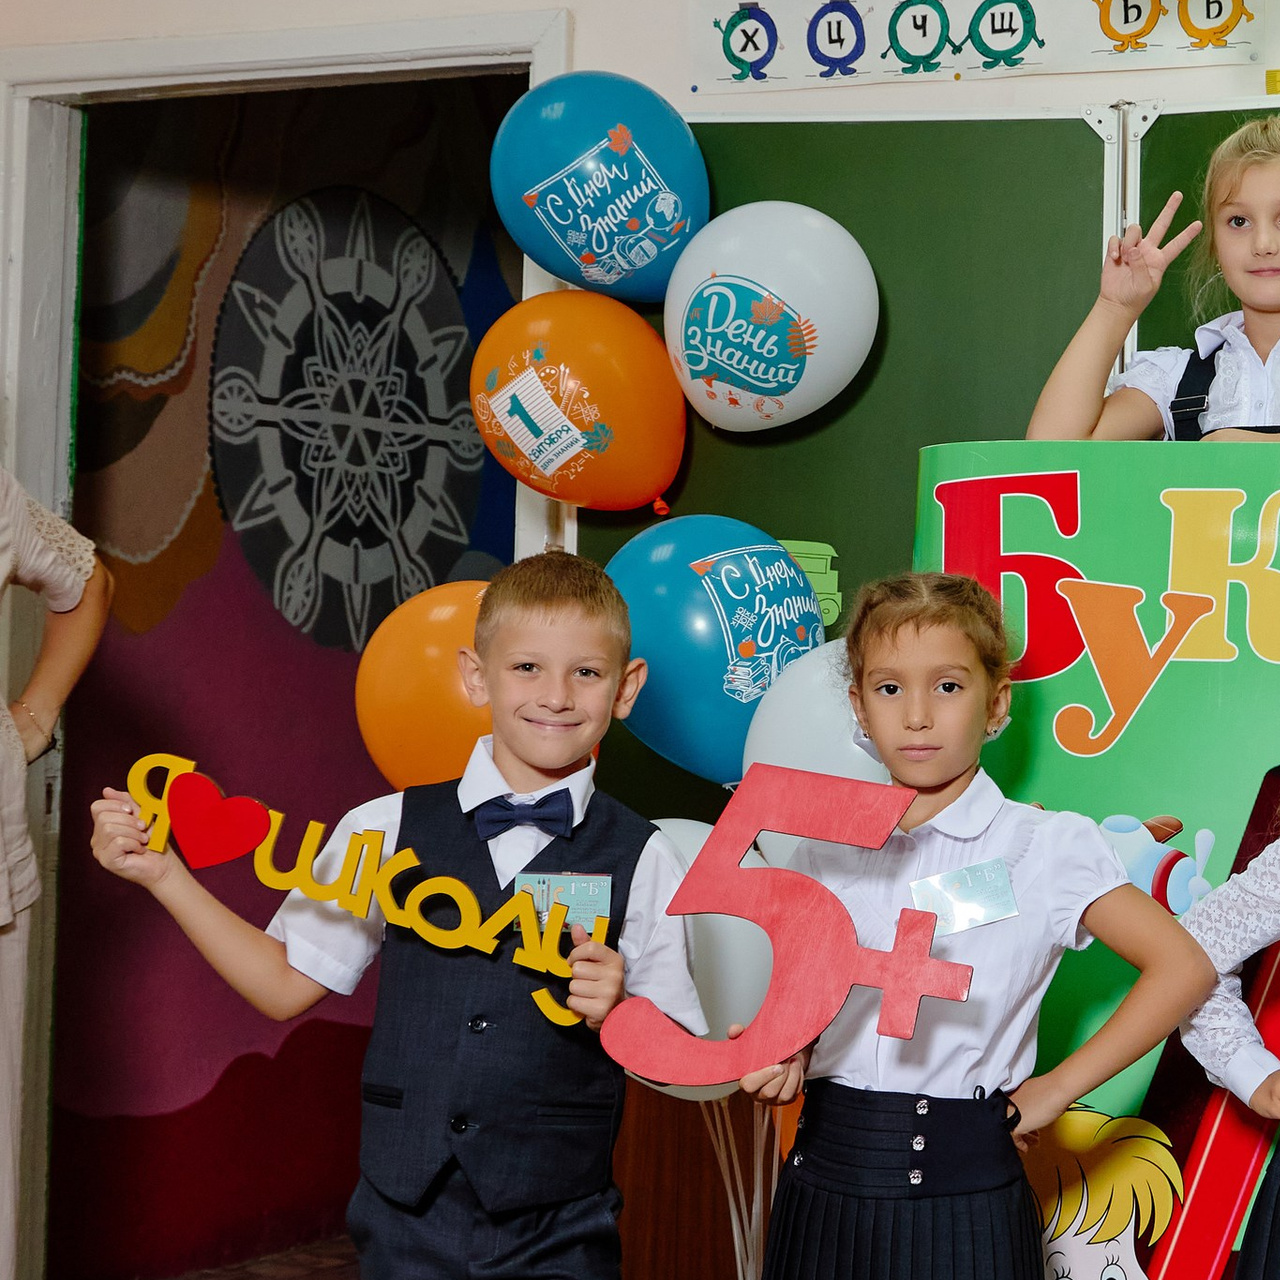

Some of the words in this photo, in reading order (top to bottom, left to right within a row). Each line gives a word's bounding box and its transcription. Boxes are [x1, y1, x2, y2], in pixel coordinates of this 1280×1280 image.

[703, 285, 779, 358] День
[506, 392, 545, 439] 1
[528, 424, 573, 462] СЕНТЯБРЯ
[553, 436, 581, 459] ЗНАНИЙ
[126, 753, 197, 854] Я
